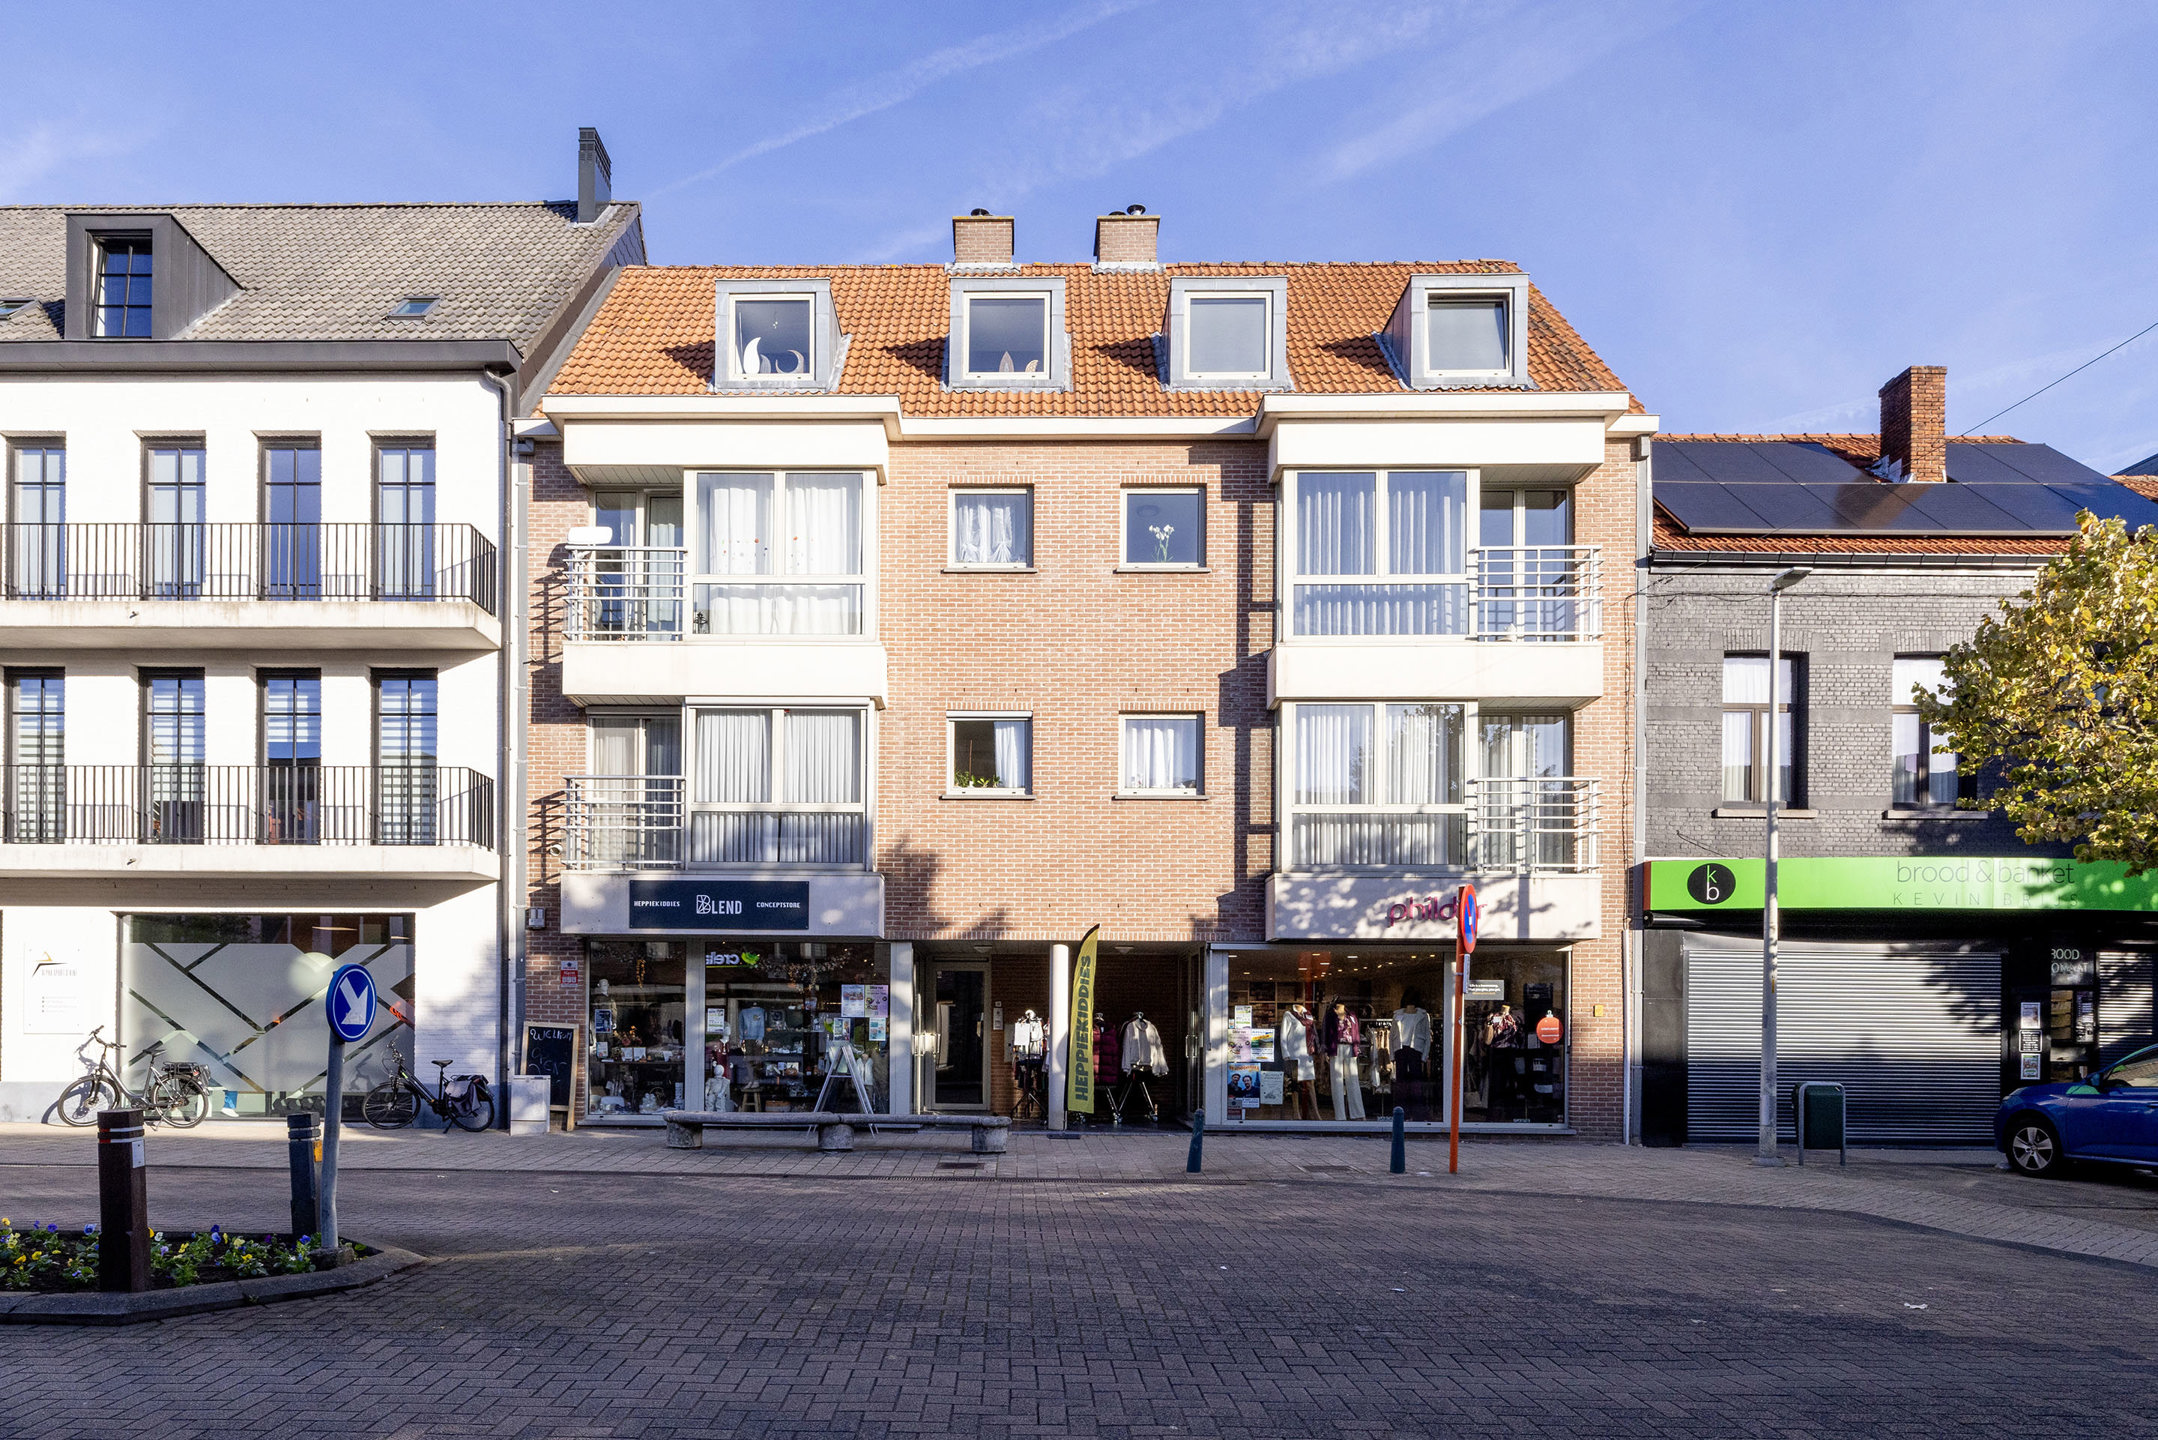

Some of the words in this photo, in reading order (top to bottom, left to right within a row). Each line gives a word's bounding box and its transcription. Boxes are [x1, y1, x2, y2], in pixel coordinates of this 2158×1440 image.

[1897, 860, 1970, 883] brood
[1975, 860, 1993, 883] &
[1998, 860, 2076, 884] banket
[633, 900, 681, 908] HEPPIEKIDDIES
[756, 901, 801, 909] CONCEPTSTORE
[1893, 892, 1981, 906] KEVIN
[2002, 892, 2079, 907] BRIJS
[1388, 896, 1488, 926] phildr
[1075, 955, 1092, 1101] HEPPIEKIDDIES
